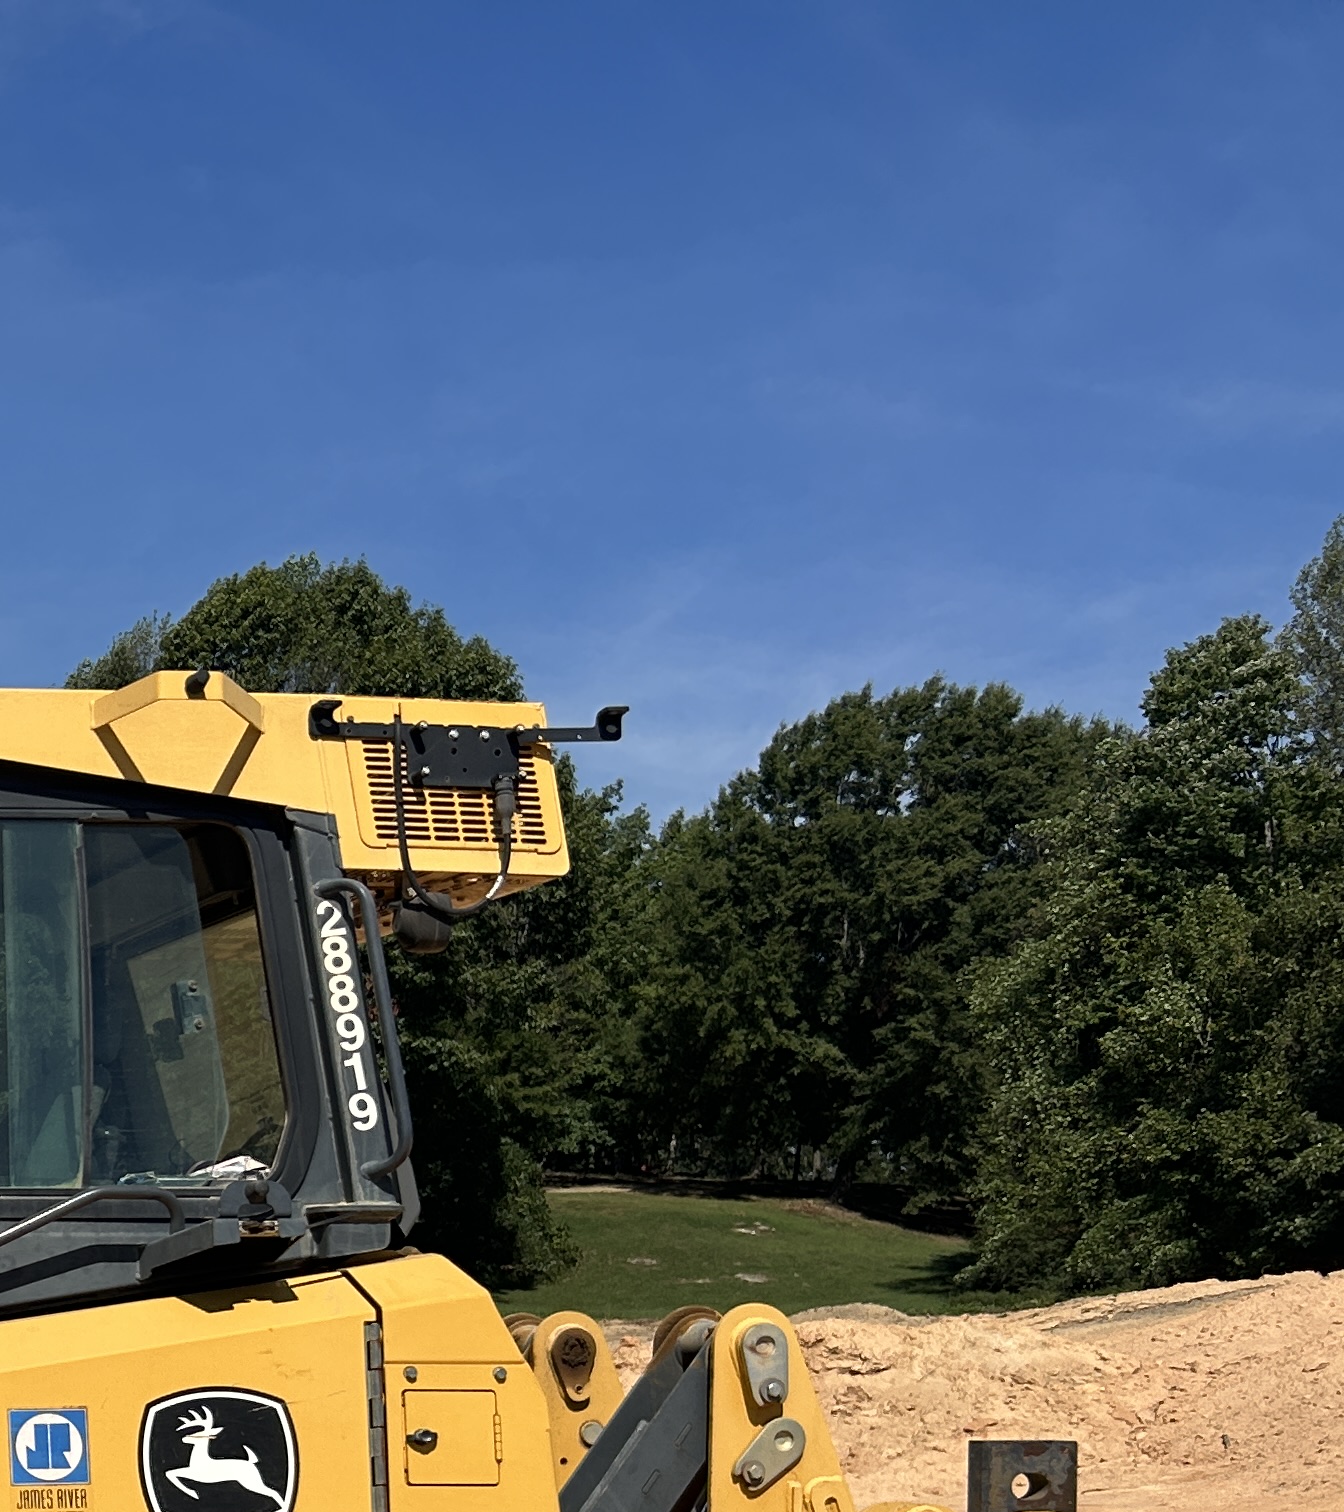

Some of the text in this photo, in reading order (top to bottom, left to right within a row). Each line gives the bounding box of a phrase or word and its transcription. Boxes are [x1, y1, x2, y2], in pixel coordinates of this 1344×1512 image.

[316, 900, 378, 1132] 288919
[16, 1488, 88, 1510] JAMES RIVER
